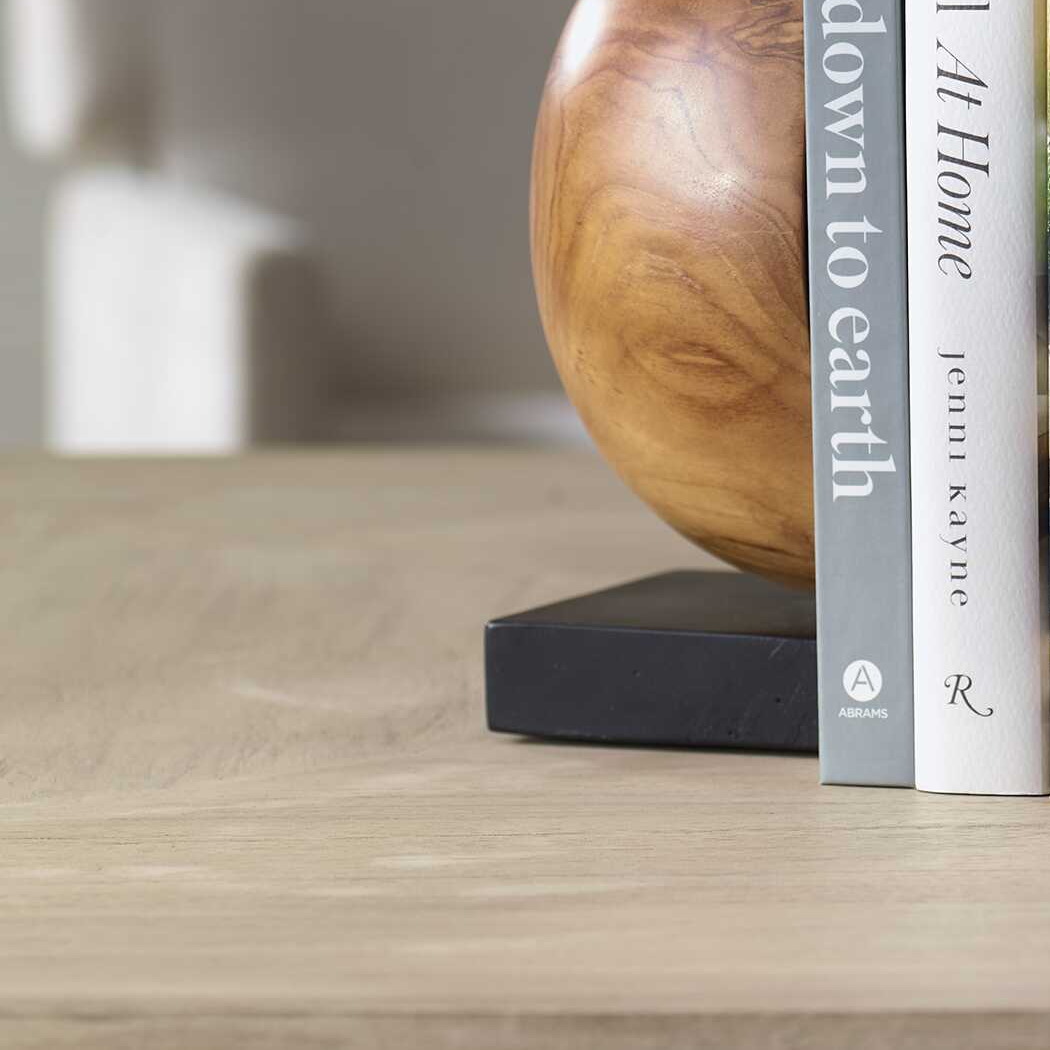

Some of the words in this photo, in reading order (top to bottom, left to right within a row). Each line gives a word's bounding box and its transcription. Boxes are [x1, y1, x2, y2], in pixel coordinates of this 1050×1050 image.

[936, 38, 989, 110] At
[937, 121, 990, 280] Home
[825, 215, 884, 289] to
[828, 306, 897, 502] earth
[838, 707, 889, 719] ABRAMS
